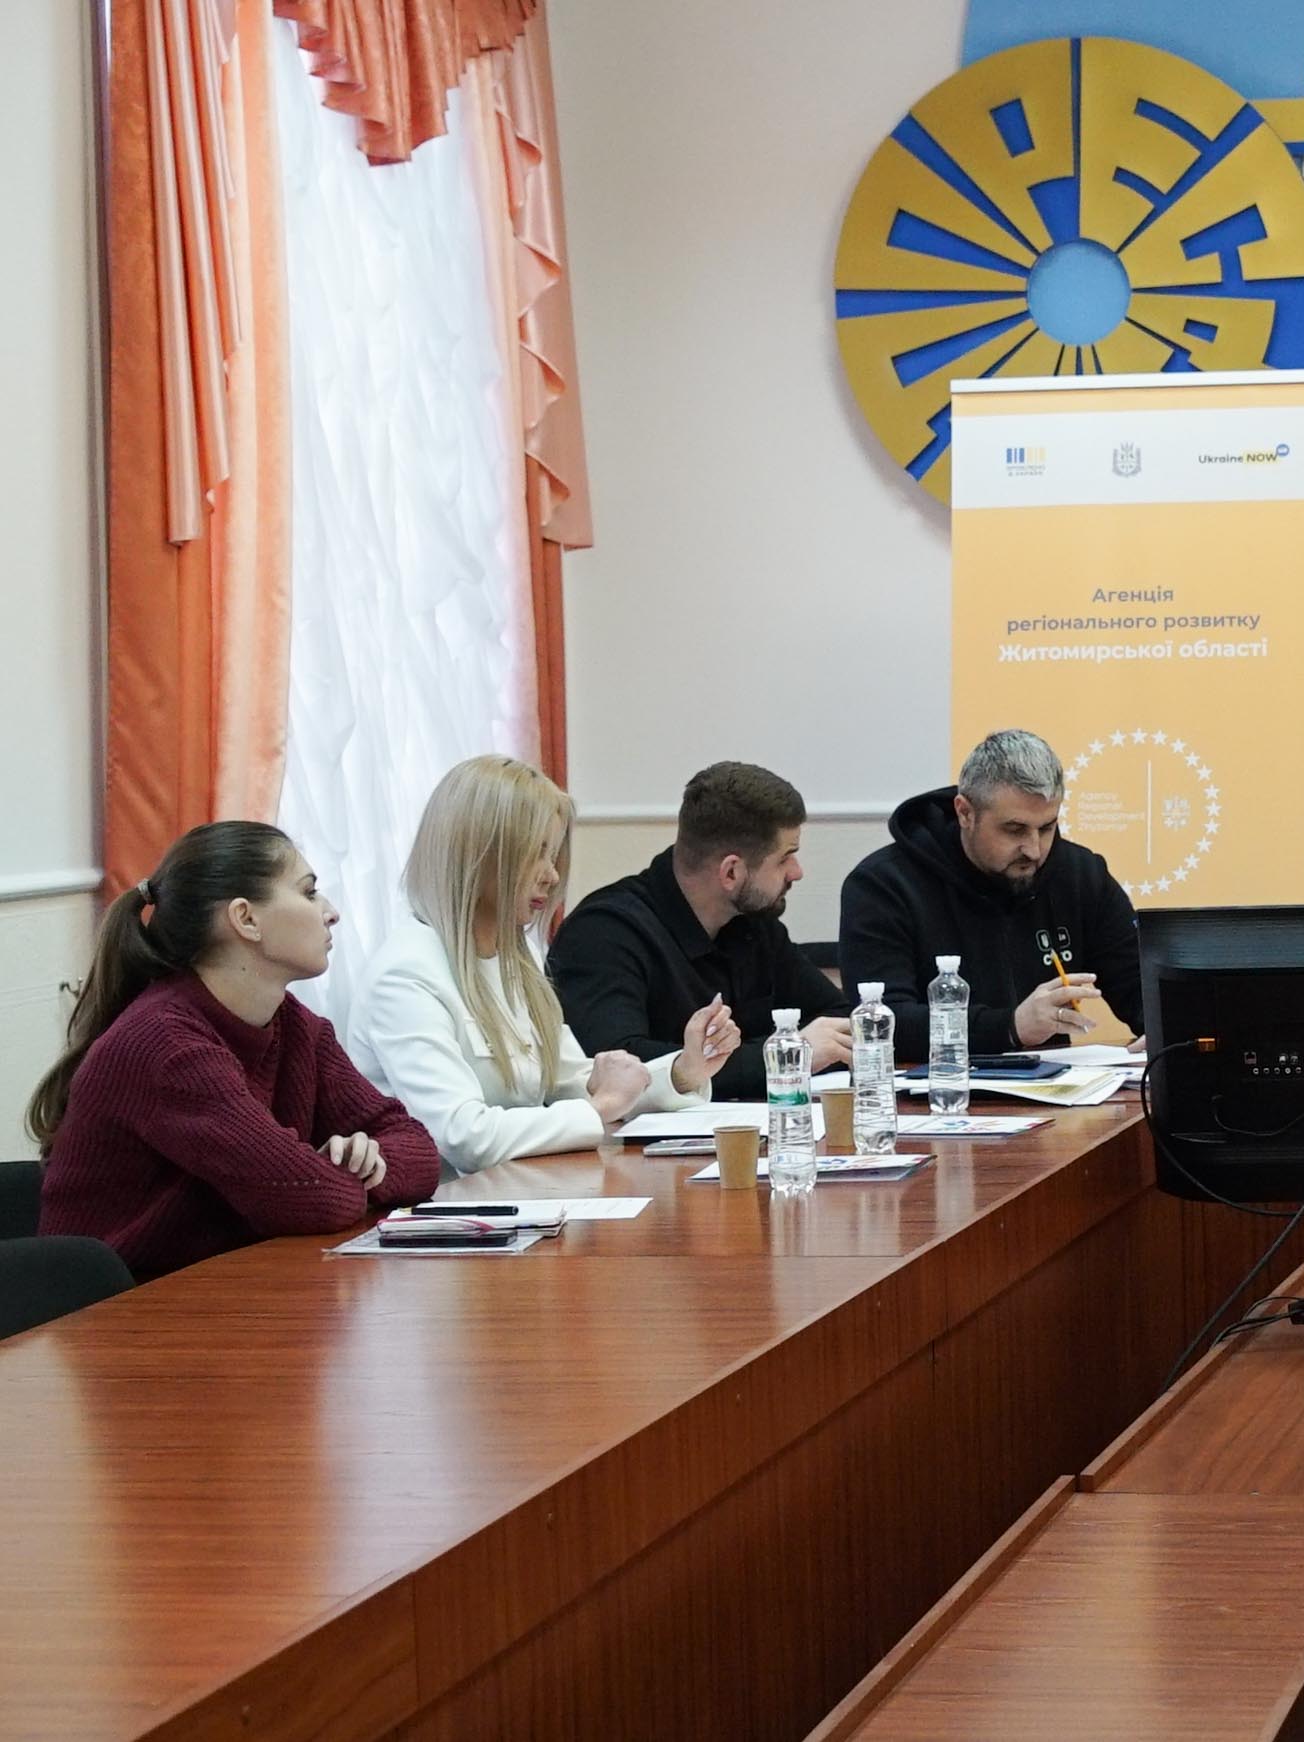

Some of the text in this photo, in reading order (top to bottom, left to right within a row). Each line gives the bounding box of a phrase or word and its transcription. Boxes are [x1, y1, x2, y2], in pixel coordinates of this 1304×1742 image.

[1198, 452, 1278, 464] Ukraine NOW
[1091, 584, 1174, 604] Агенція
[1007, 612, 1261, 635] регіонального розвитку
[998, 637, 1268, 664] Житомирської області
